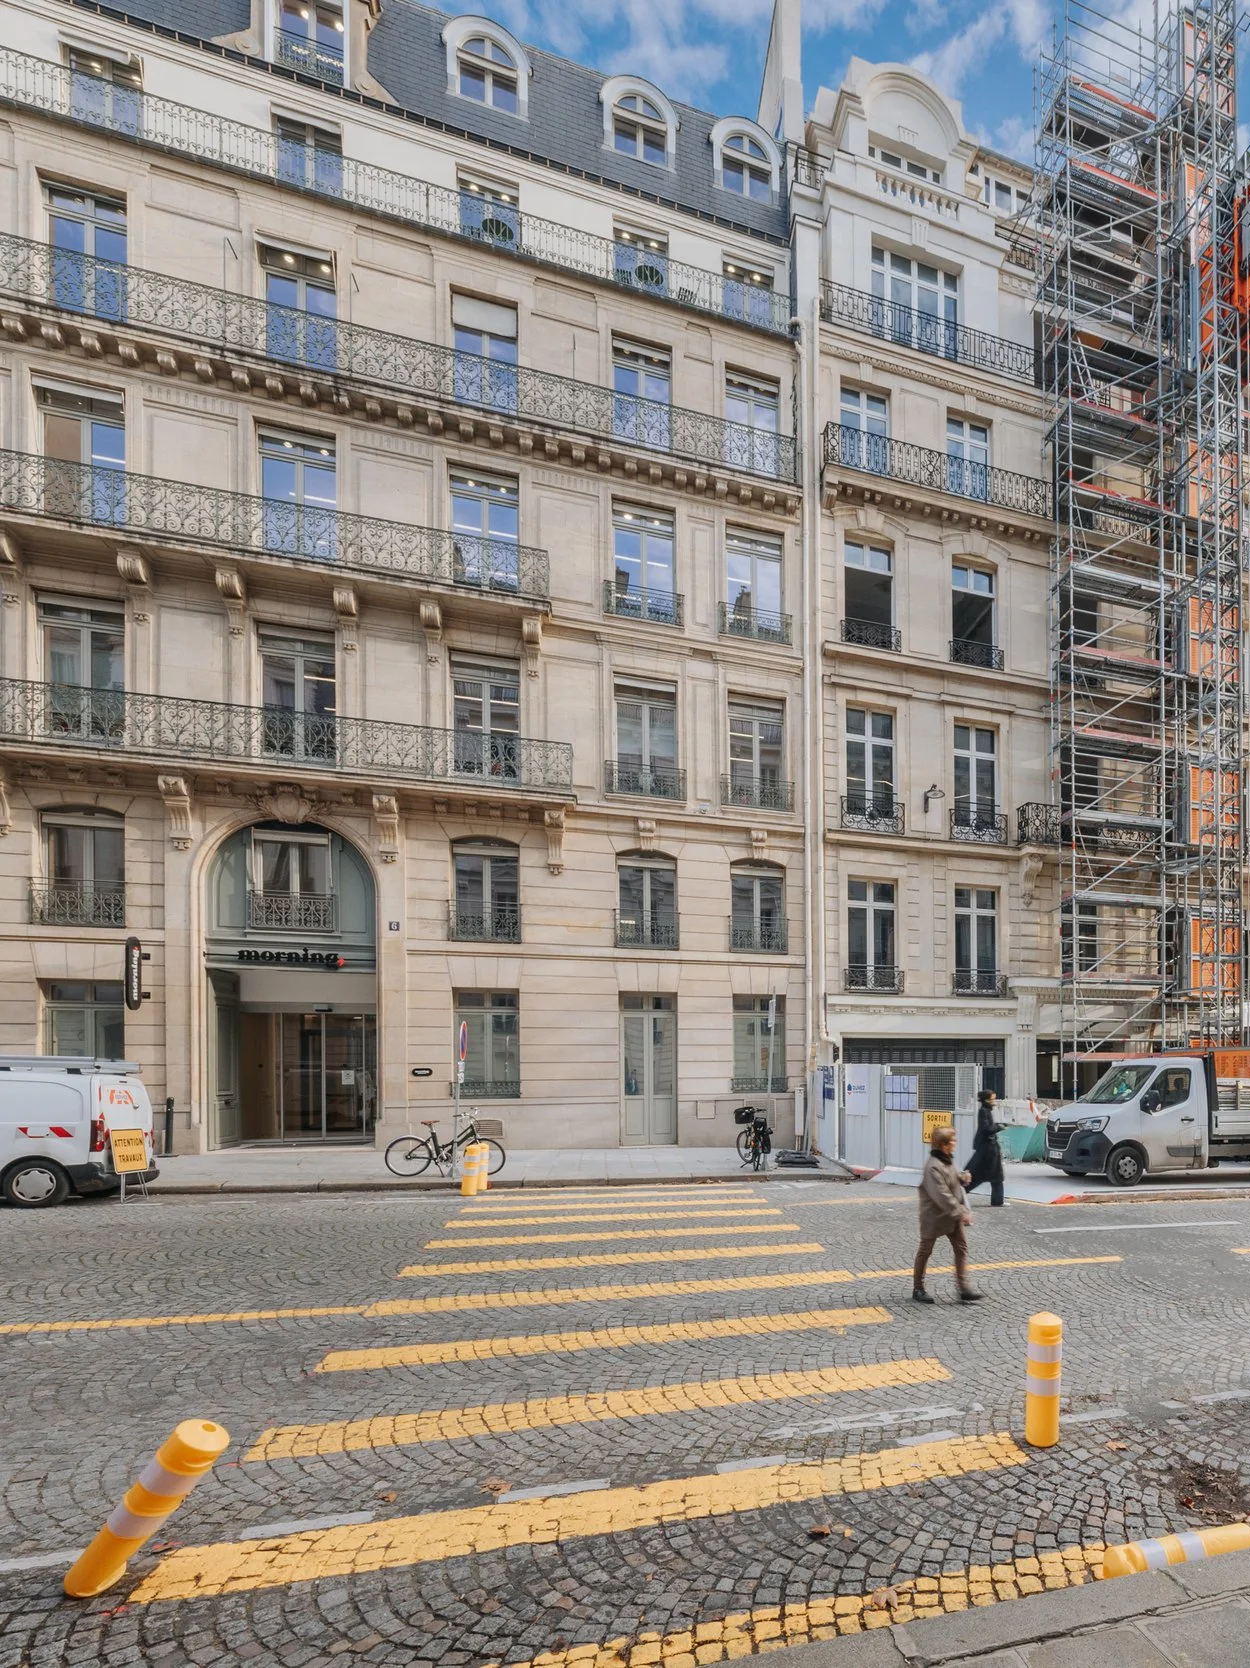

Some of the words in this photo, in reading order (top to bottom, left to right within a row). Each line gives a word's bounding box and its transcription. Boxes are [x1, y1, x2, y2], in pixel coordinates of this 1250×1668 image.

[391, 922, 398, 930] 6
[237, 947, 339, 971] morning
[131, 947, 140, 1001] morning
[926, 1114, 947, 1122] SORTIE
[114, 1137, 143, 1147] ATTENTION
[118, 1152, 143, 1162] TRAVAUX
